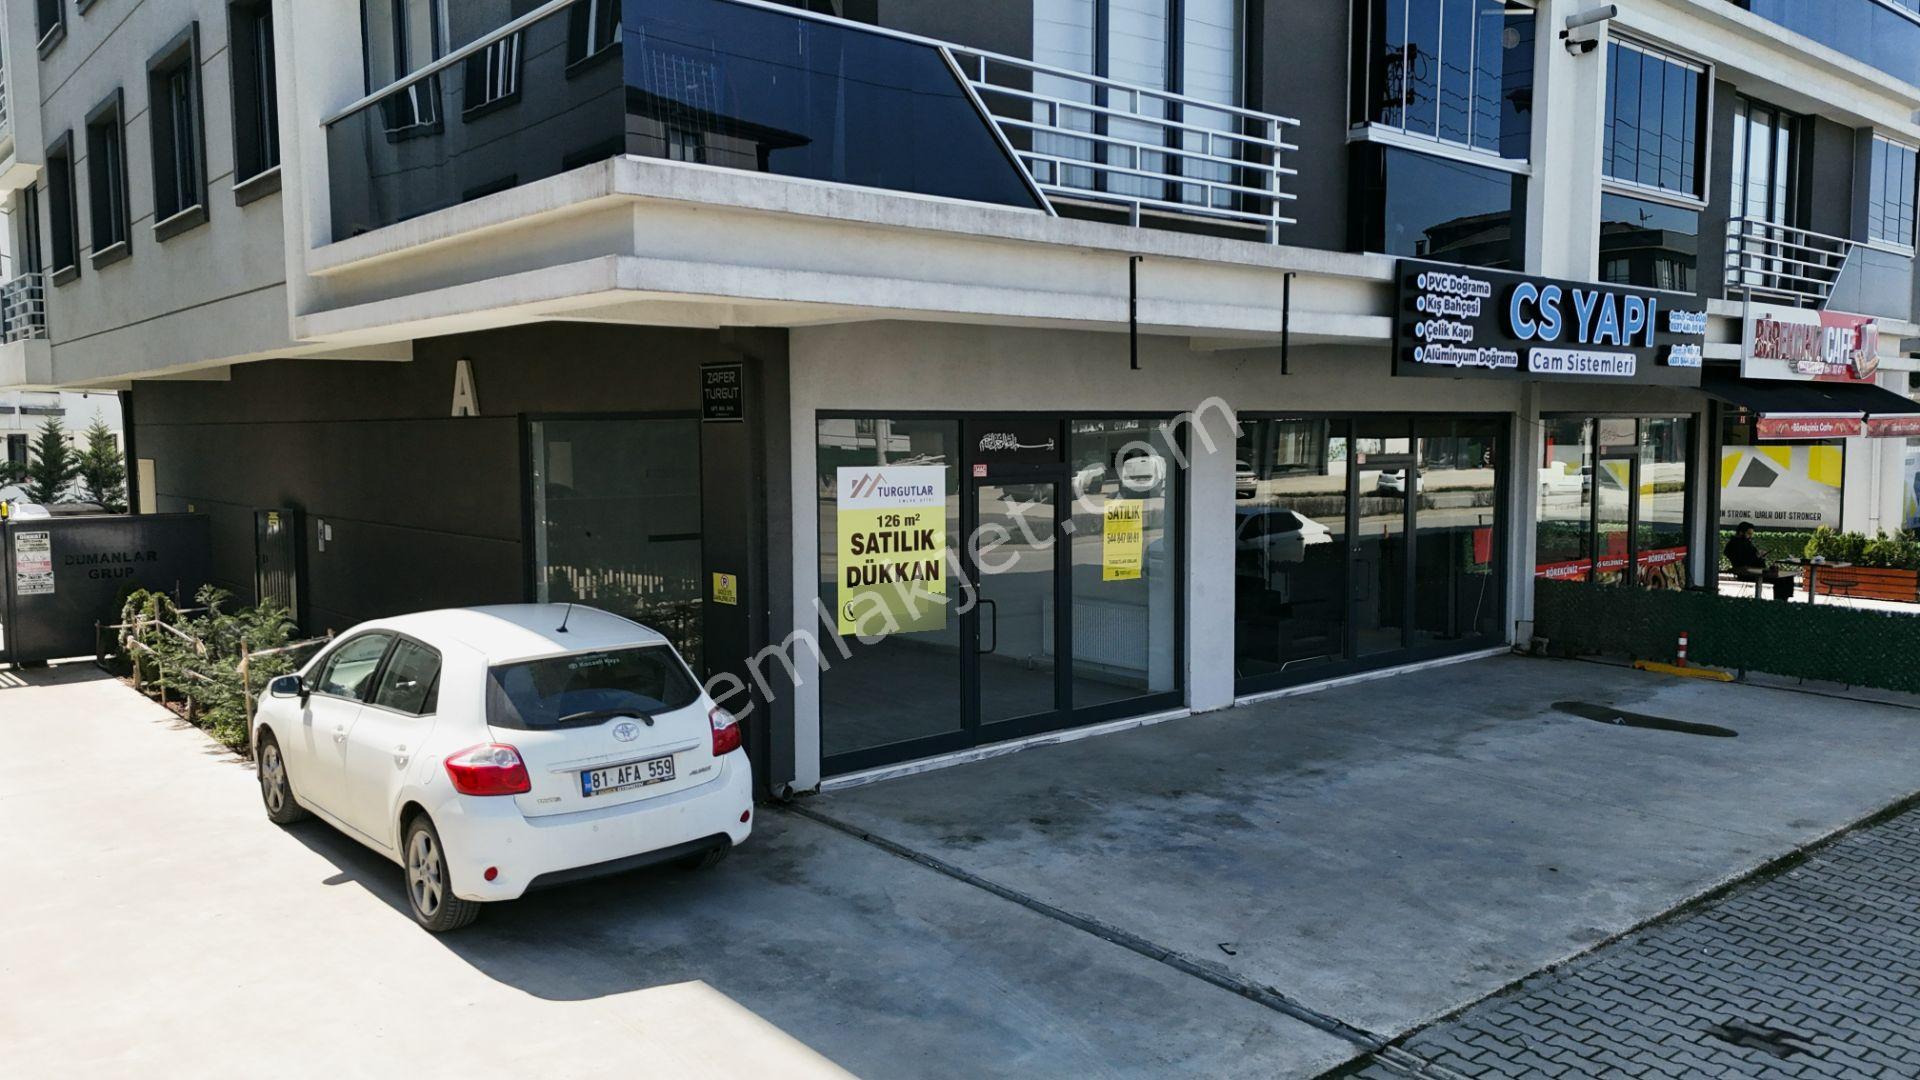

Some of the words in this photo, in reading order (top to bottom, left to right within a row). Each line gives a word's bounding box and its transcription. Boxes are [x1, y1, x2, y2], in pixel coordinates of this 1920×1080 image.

[1427, 274, 1448, 290] PVC
[1449, 277, 1490, 295] Doğrama
[1426, 296, 1442, 315] Kış
[1443, 298, 1479, 317] Bahçesi
[1510, 282, 1562, 342] CS
[1572, 289, 1657, 347] YAPI
[1426, 321, 1449, 340] Çelik
[1451, 323, 1473, 341] Kapı
[1424, 346, 1477, 364] Alüminyum
[1478, 349, 1517, 367] Doğrama
[1533, 352, 1563, 369] Cam
[1567, 353, 1634, 374] Sistemleri
[706, 371, 736, 384] ZAFER
[452, 360, 480, 416] A
[704, 387, 739, 399] TURGUT
[877, 485, 934, 497] TURGUTLAR
[876, 515, 901, 527] 126
[1107, 505, 1140, 520] SATILIK
[1775, 511, 1787, 520] OUT
[1789, 512, 1822, 521] STRONGER
[851, 529, 935, 555] SATILIK
[65, 550, 158, 565] DUMANLAR
[88, 567, 135, 579] GRUP
[846, 559, 939, 588] DÜKKAN
[592, 771, 607, 788] 81
[618, 765, 642, 784] AFA
[649, 759, 672, 777] 559
